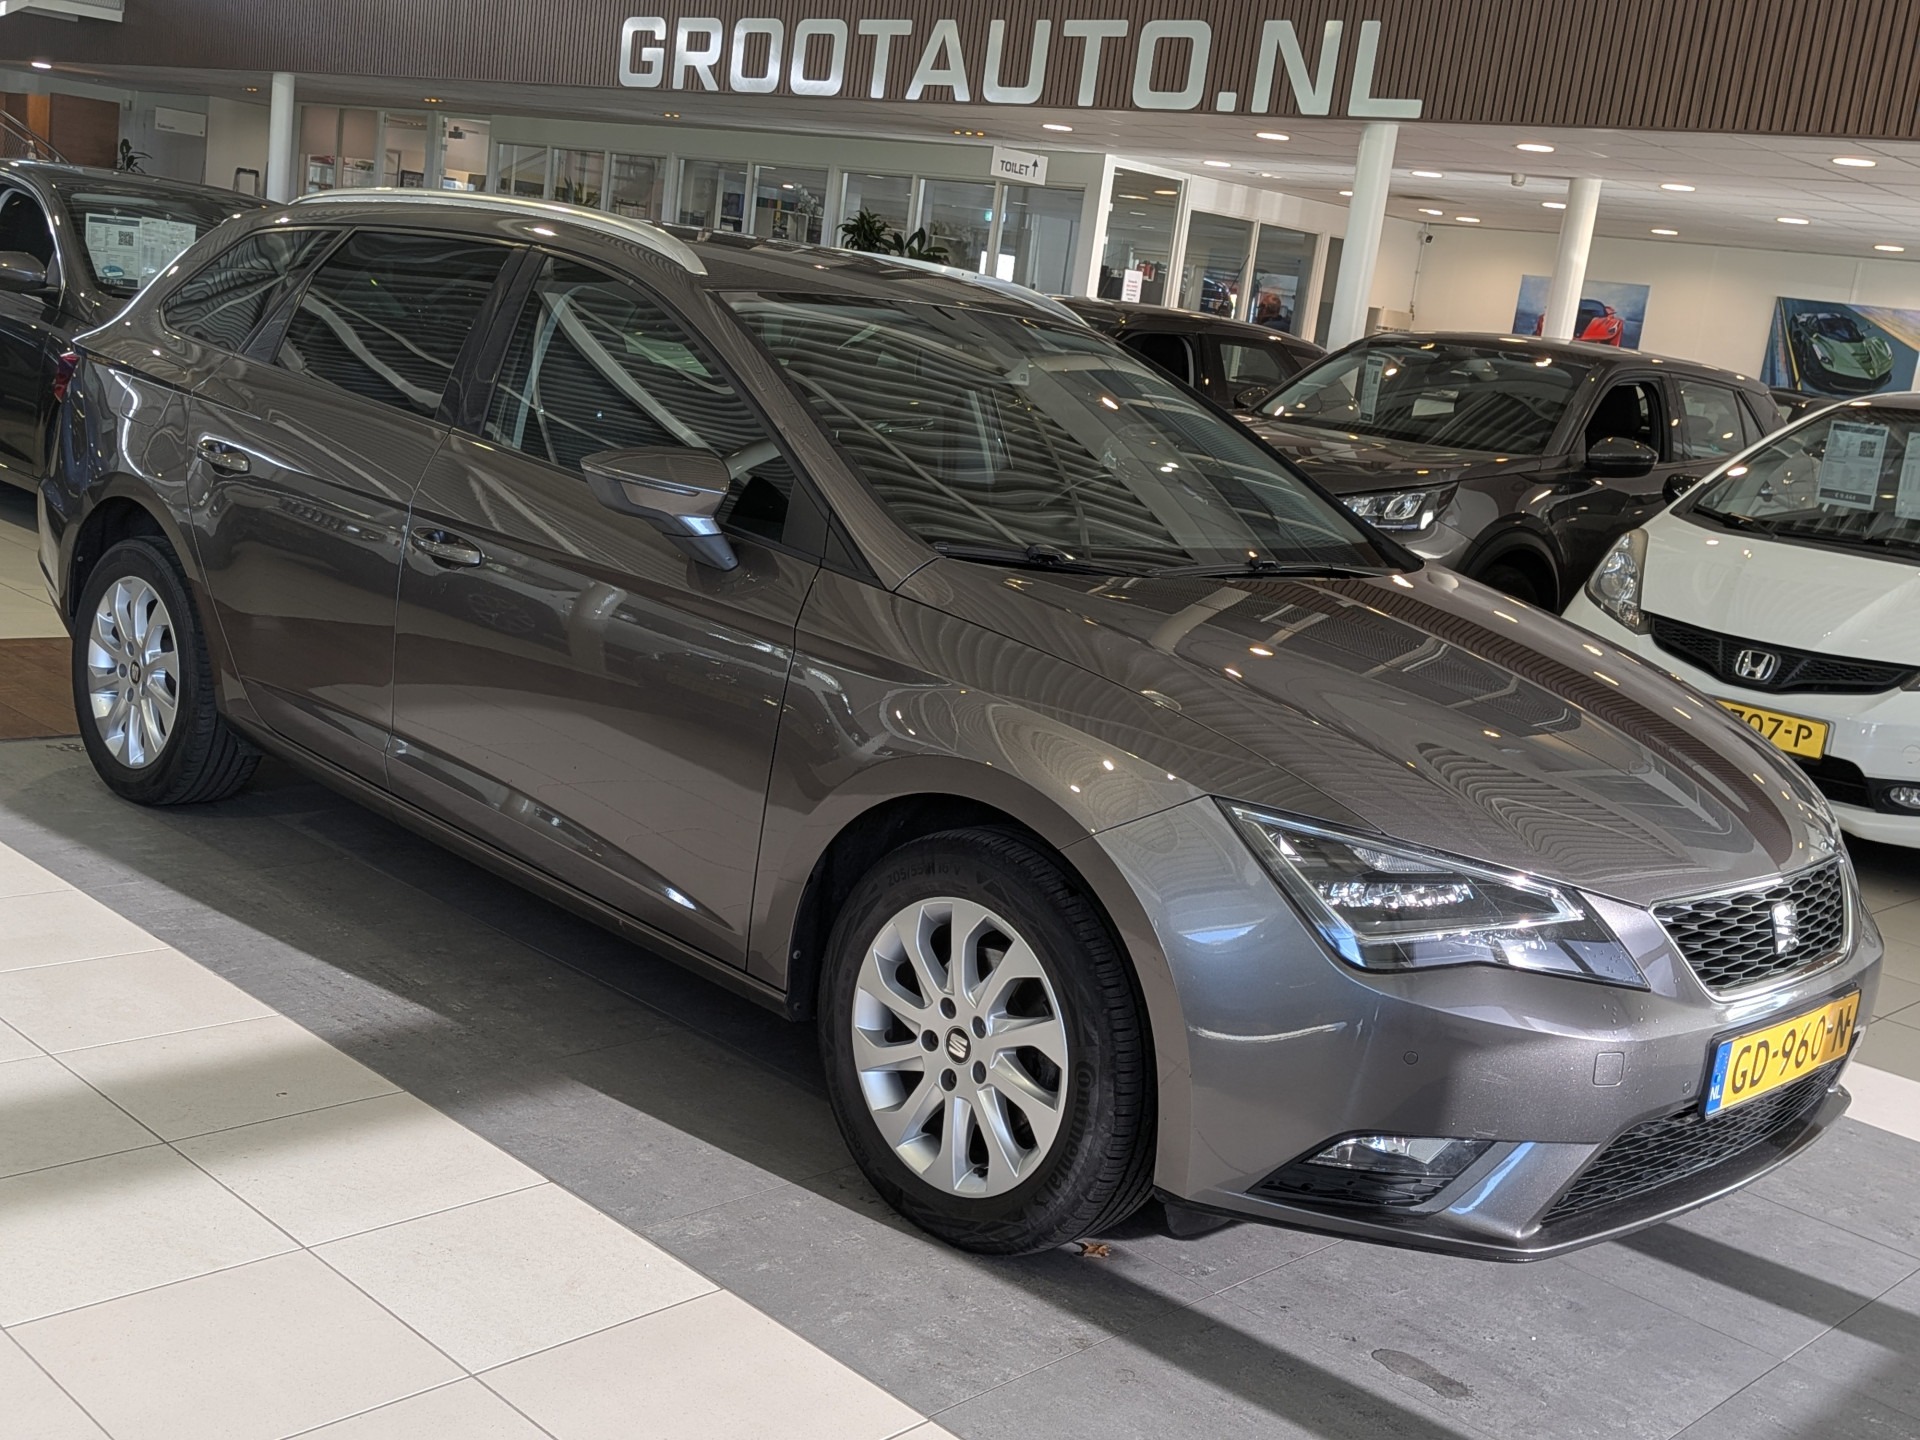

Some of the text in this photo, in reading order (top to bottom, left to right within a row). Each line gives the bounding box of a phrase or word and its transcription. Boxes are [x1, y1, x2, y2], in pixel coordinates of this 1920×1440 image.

[618, 16, 1423, 119] GROOTAUTO.NL
[1000, 159, 1030, 176] TOILET
[1731, 1004, 1853, 1095] GD-960-N
[1709, 1084, 1722, 1101] NL
